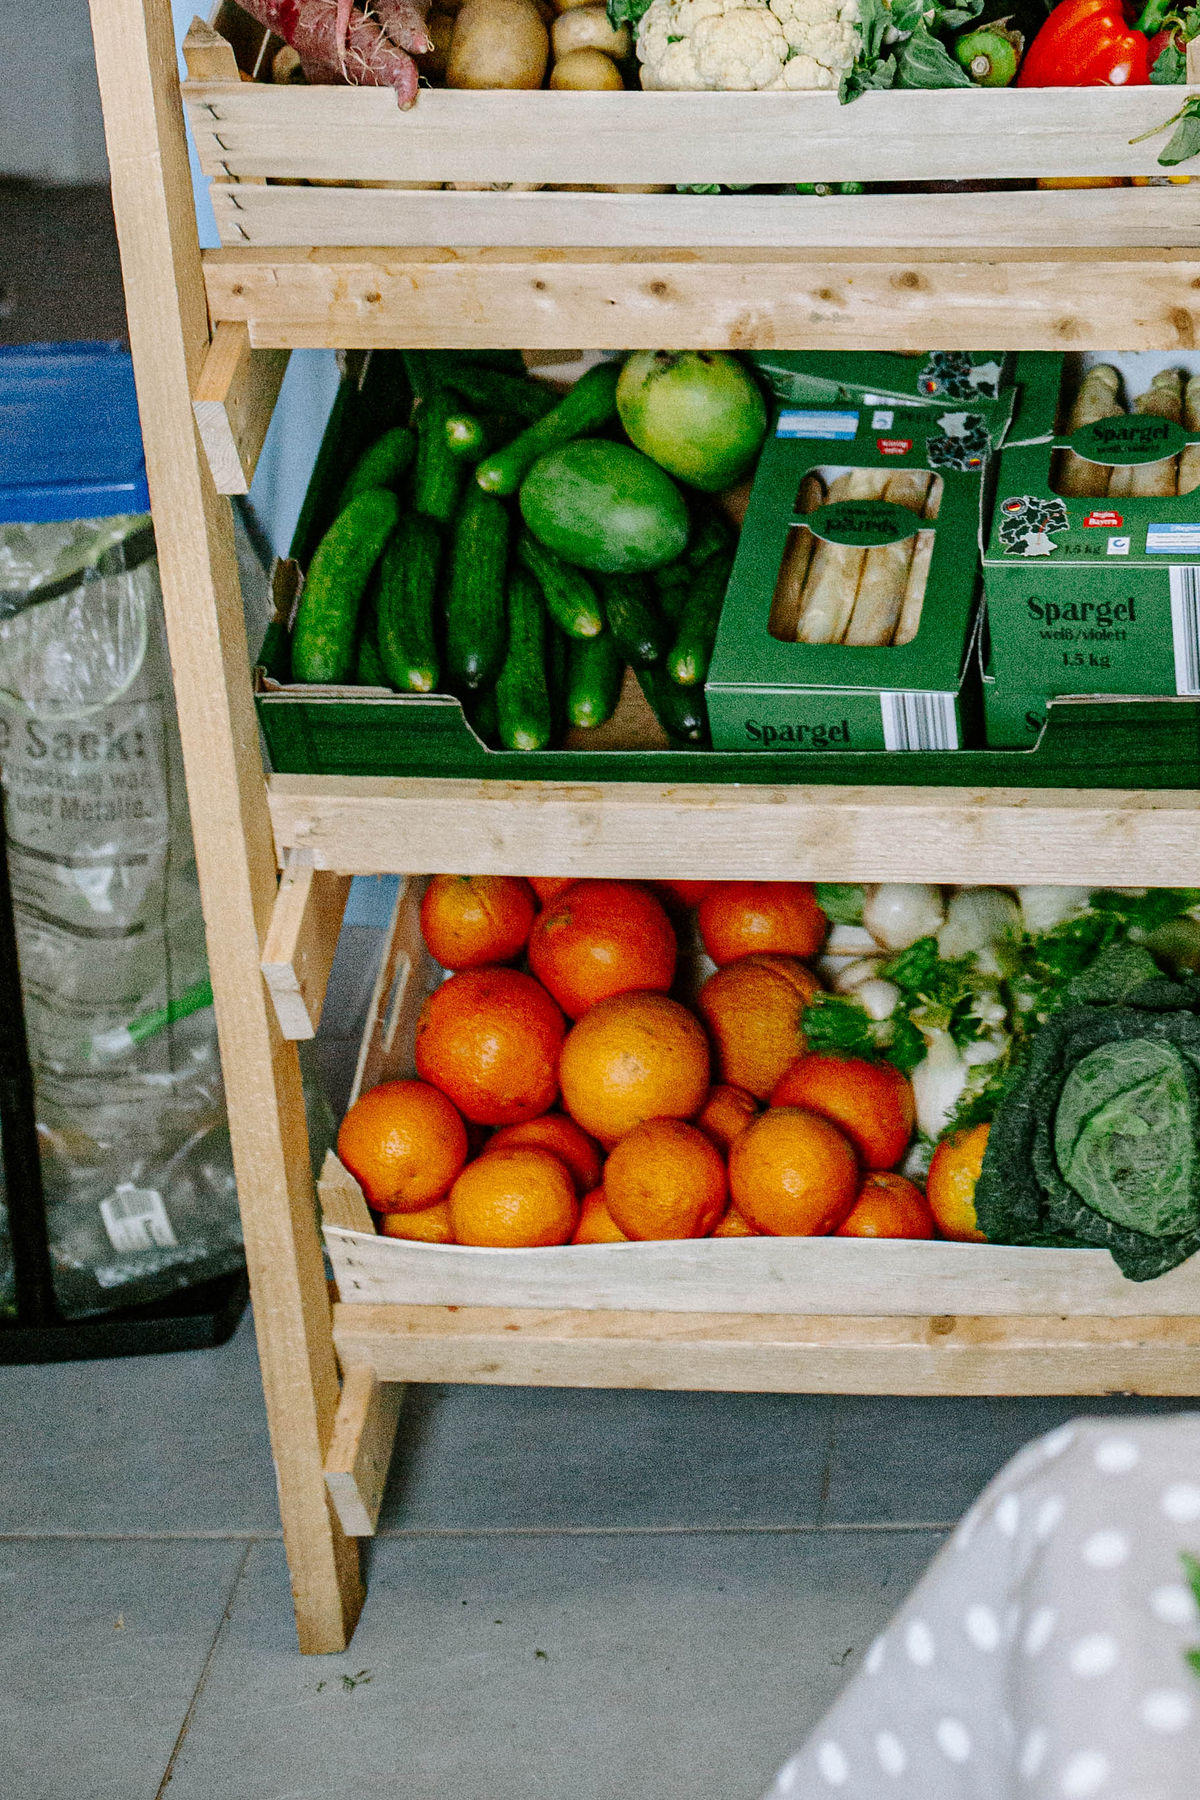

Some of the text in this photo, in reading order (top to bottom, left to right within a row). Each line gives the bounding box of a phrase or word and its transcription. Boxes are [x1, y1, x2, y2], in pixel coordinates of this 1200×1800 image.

[1092, 423, 1170, 444] Spargel
[1088, 517, 1118, 527] Bayern
[1027, 596, 1137, 628] Spargel
[1088, 652, 1111, 670] kg
[744, 718, 851, 748] Spargel
